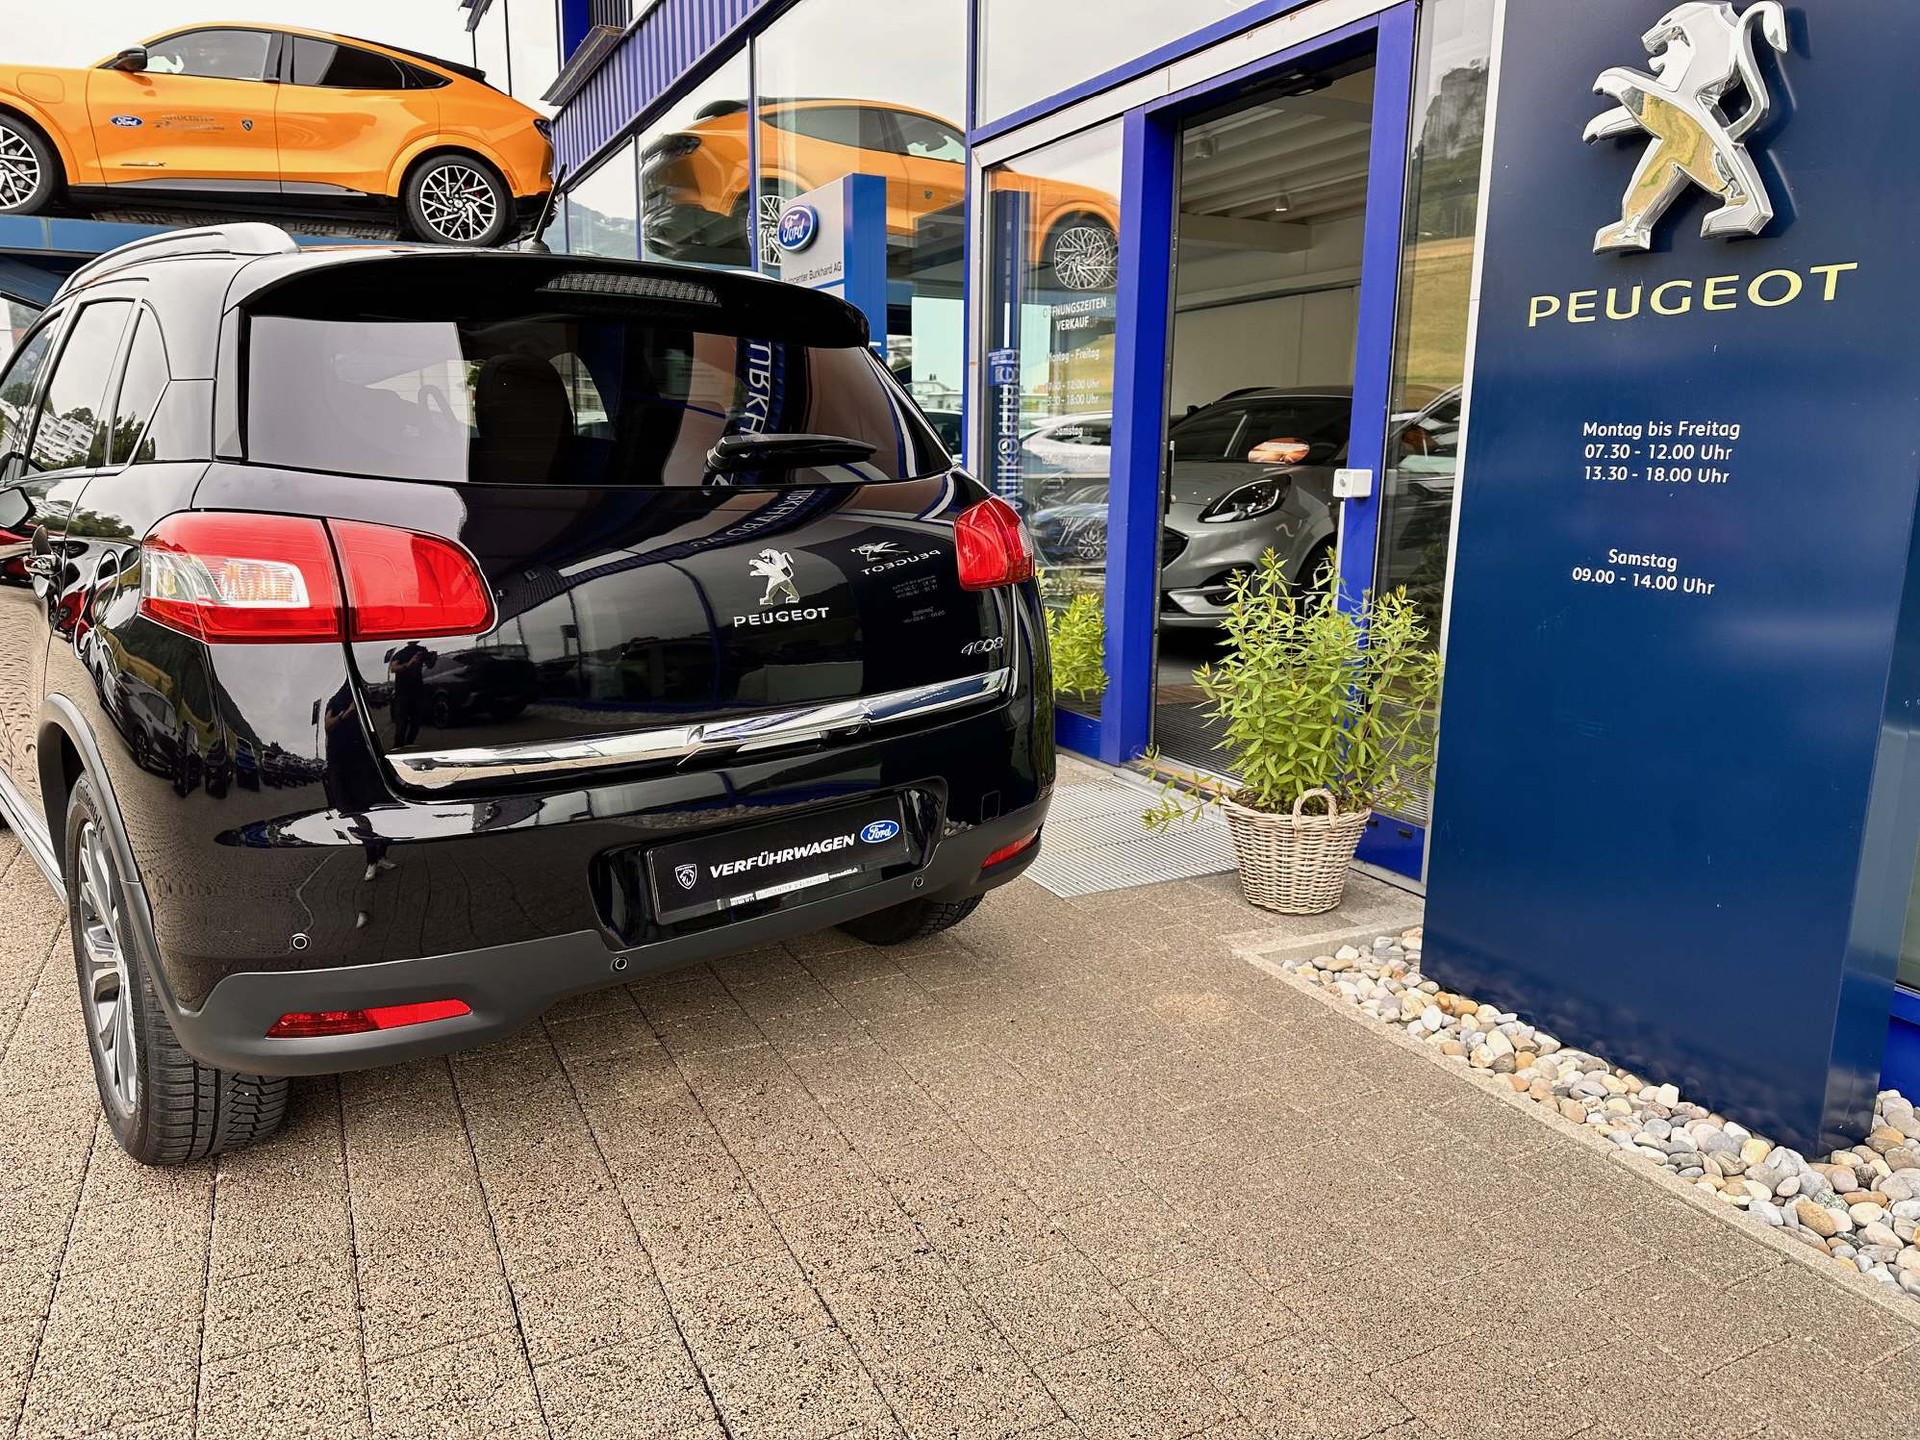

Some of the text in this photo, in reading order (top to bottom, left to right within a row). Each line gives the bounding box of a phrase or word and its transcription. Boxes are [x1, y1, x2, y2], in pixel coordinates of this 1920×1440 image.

[809, 263, 833, 280] Burkhard
[833, 261, 842, 273] AG
[1528, 262, 1858, 327] PEUGEOT
[1056, 316, 1090, 331] VERKAUF
[1075, 347, 1100, 360] Freitag
[1086, 393, 1099, 404] Uhr
[1055, 426, 1083, 438] Samstag
[1583, 421, 1741, 440] Montag bis Freitag
[1584, 444, 1631, 459] 07.30
[1649, 444, 1695, 460] 12.00
[1700, 444, 1733, 460] Uhr
[1585, 466, 1628, 480] 13.30
[1646, 467, 1692, 482] 18.00
[1698, 468, 1730, 483] Uhr
[1608, 549, 1678, 572] Samstag
[1572, 567, 1616, 584] 09.00
[1633, 573, 1678, 590] 14.00
[1683, 577, 1715, 595] Uhr
[734, 607, 830, 628] PEUGEOT
[961, 637, 1004, 656] 4008
[709, 823, 892, 878] VERFÜHRWAGEN Ford
